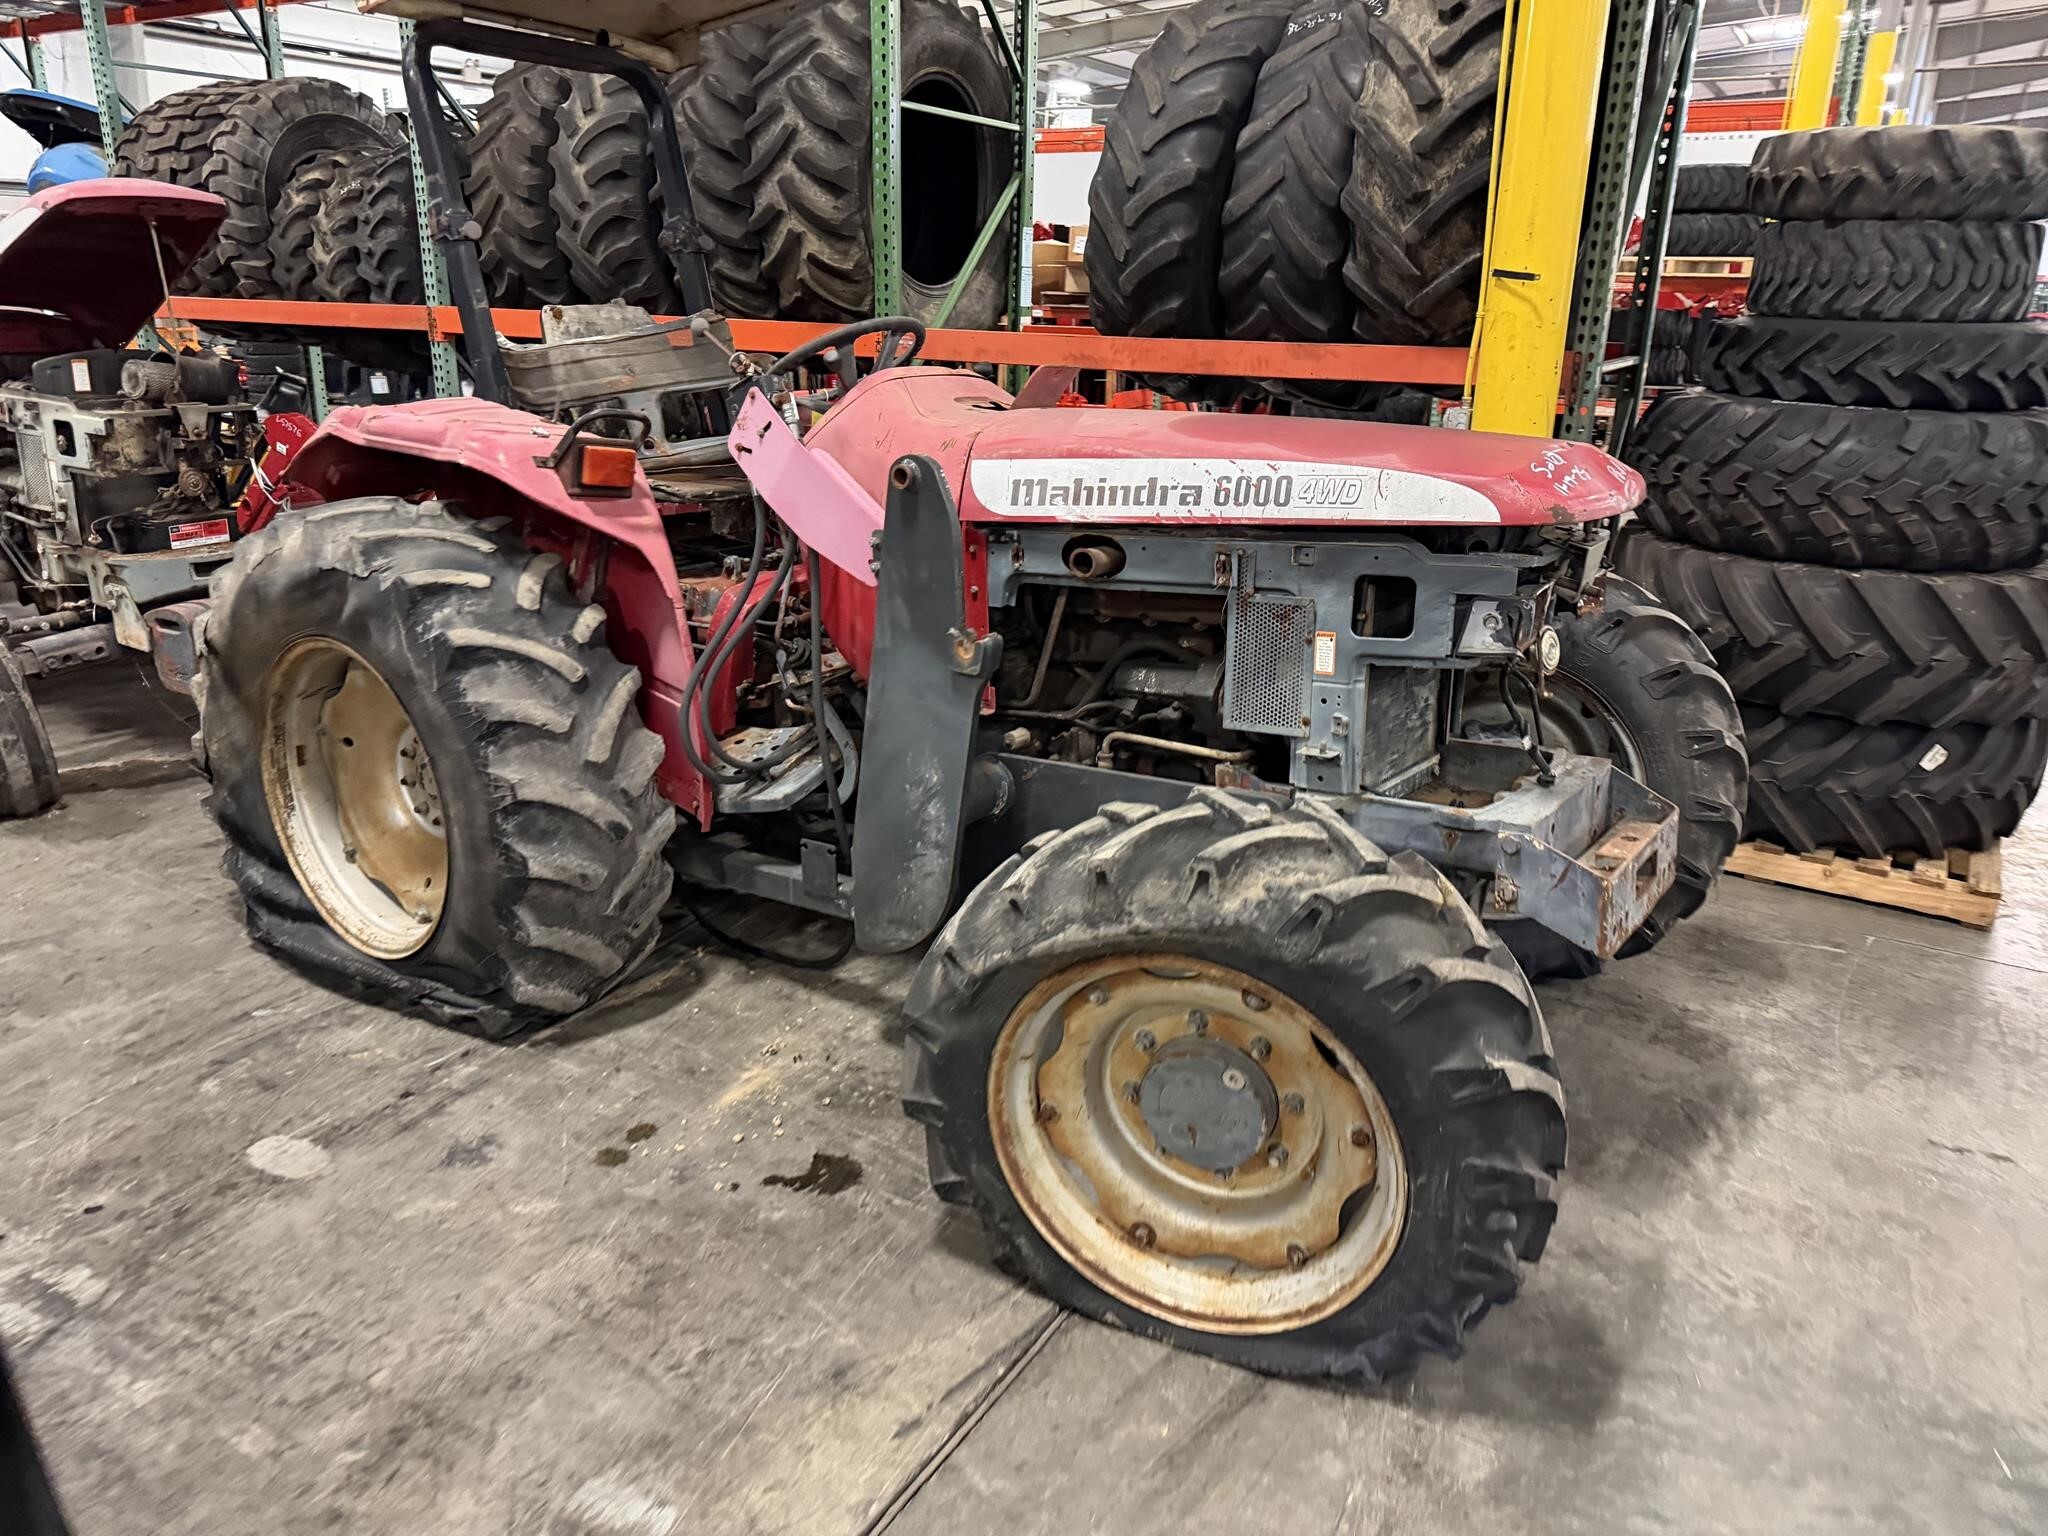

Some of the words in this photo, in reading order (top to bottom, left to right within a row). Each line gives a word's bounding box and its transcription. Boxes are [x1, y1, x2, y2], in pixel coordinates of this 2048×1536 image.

[1010, 476, 1203, 507] Mahindra
[1213, 475, 1294, 508] 6000
[1298, 477, 1363, 505] 4WD
